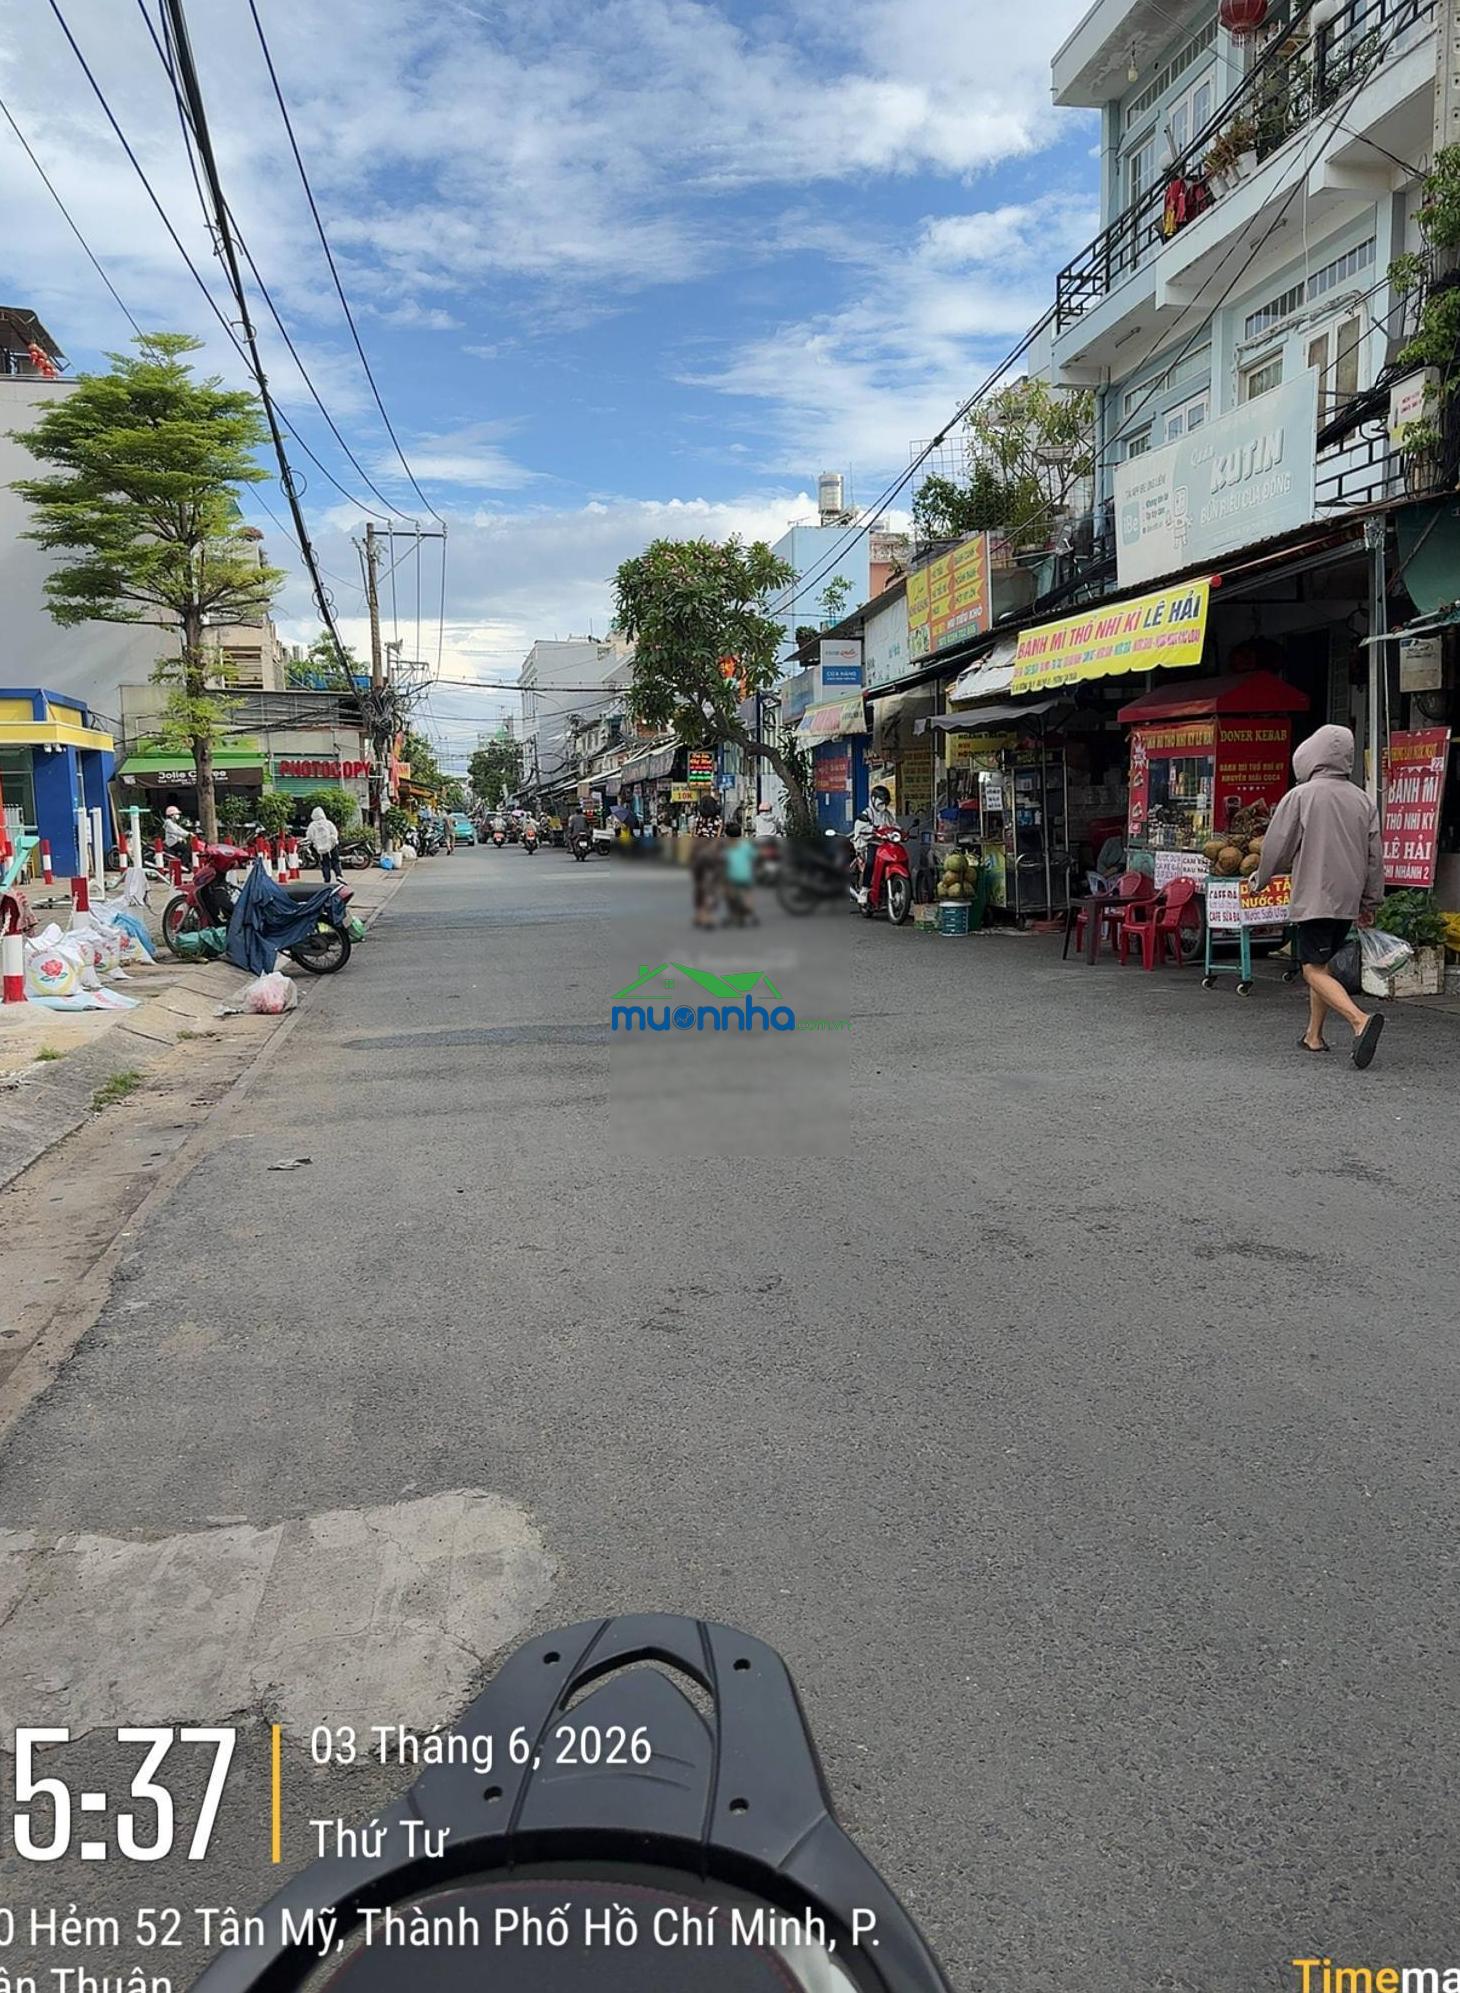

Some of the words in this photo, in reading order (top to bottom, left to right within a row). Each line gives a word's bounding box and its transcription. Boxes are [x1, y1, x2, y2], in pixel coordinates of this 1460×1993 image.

[1017, 634, 1048, 660] BÁNH
[1143, 600, 1165, 628] LÊ
[1168, 589, 1201, 621] HẢI
[1220, 730, 1253, 742] DONER
[1255, 729, 1287, 741] KEBAB
[279, 760, 370, 778] PHOTOCOPY
[1388, 771, 1419, 803] BÁNH
[1422, 771, 1439, 803] MÌ
[1386, 806, 1404, 830] THỔ
[1422, 808, 1435, 830] KỲ
[1383, 836, 1400, 859] LÊ
[1403, 834, 1432, 860] HẢI
[1395, 862, 1422, 879] NHÁNH
[1422, 866, 1430, 880] 2
[1241, 895, 1274, 909] NƯỚC
